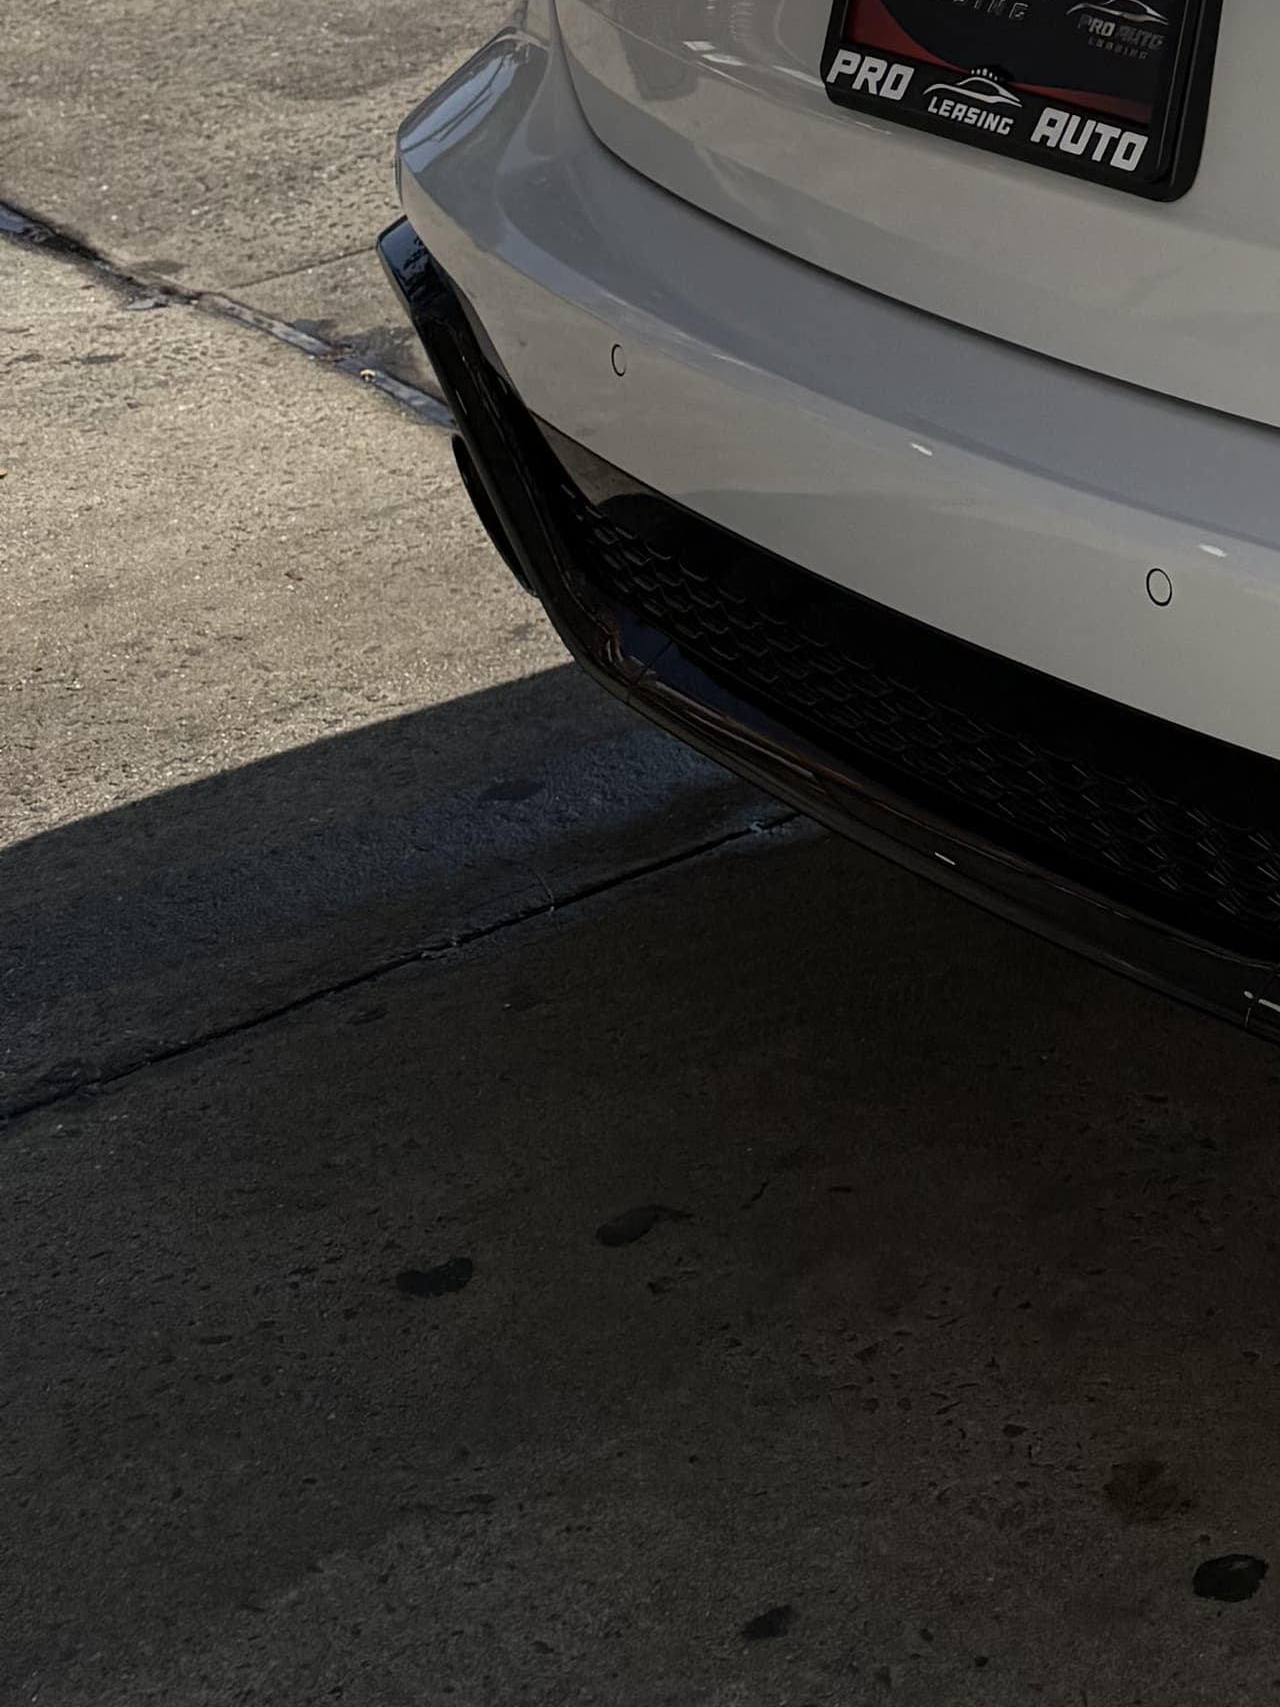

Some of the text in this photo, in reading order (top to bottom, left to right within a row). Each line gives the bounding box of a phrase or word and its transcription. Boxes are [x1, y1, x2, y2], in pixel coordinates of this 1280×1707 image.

[1078, 14, 1166, 50] PRO AUTO
[826, 48, 1149, 173] PRO LEASING AUTO
